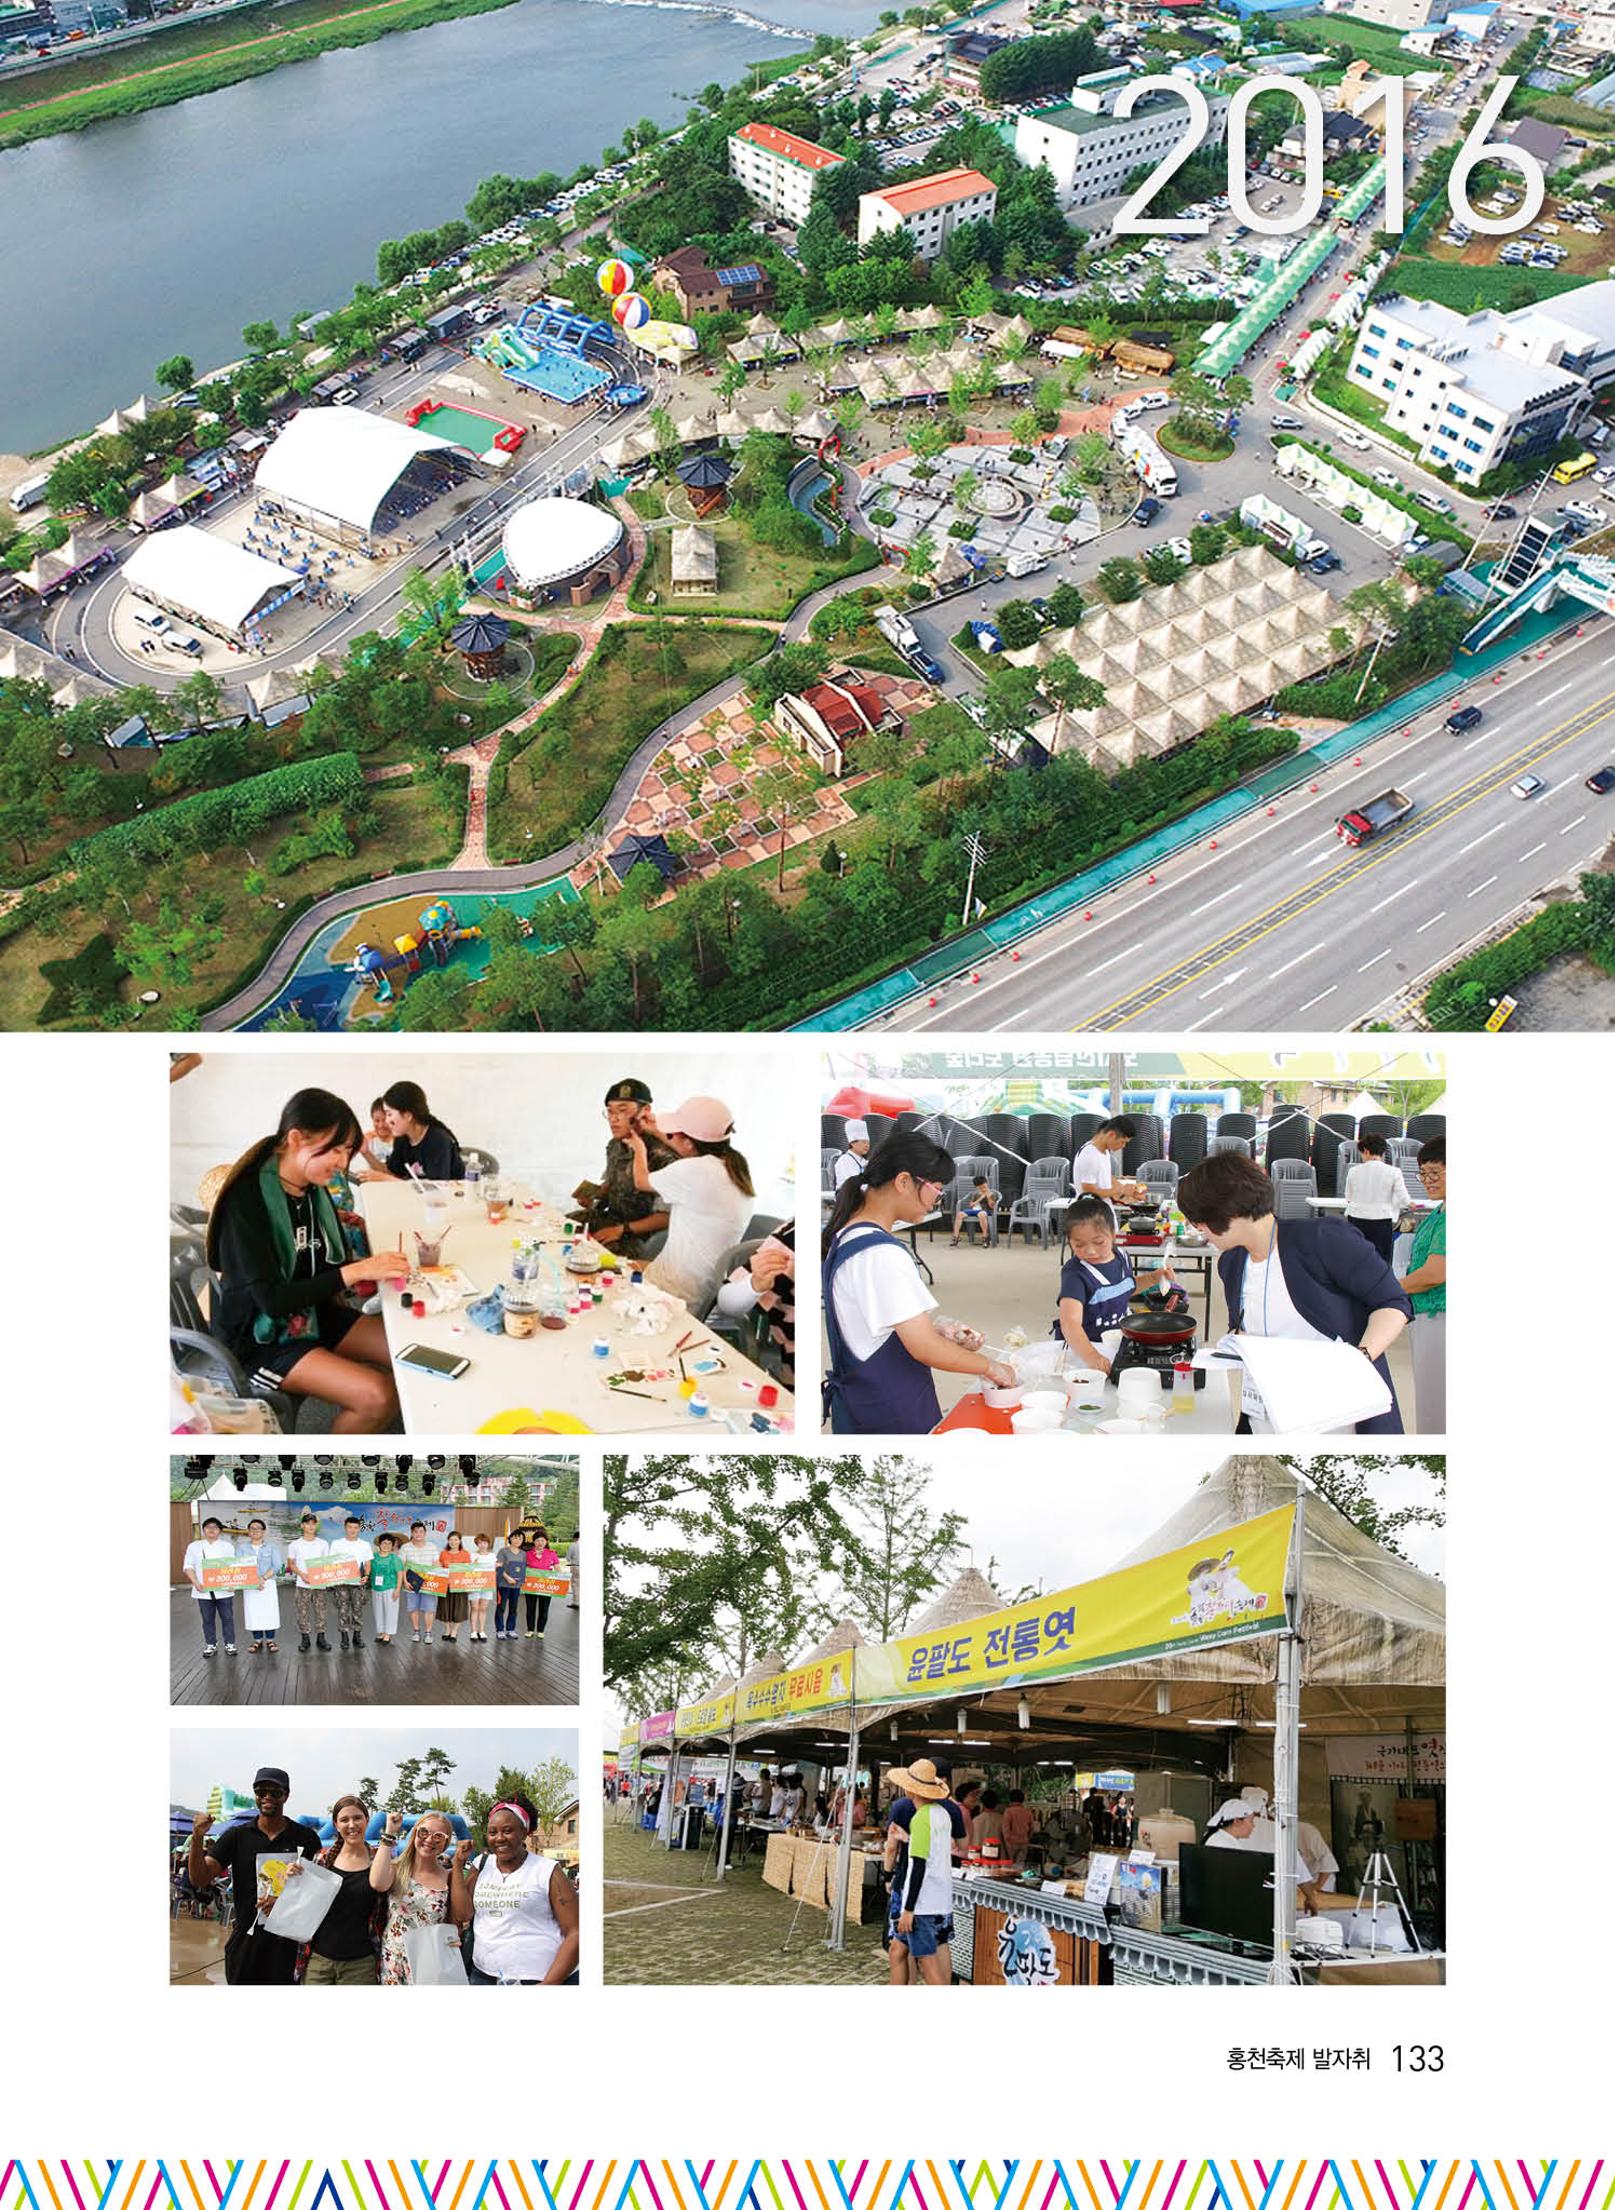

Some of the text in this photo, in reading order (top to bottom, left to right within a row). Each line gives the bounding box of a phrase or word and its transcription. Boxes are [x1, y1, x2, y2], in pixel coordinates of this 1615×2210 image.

[907, 1607, 1076, 1682] 윤팔도 전통엿
[788, 1667, 824, 1698] 무료시음
